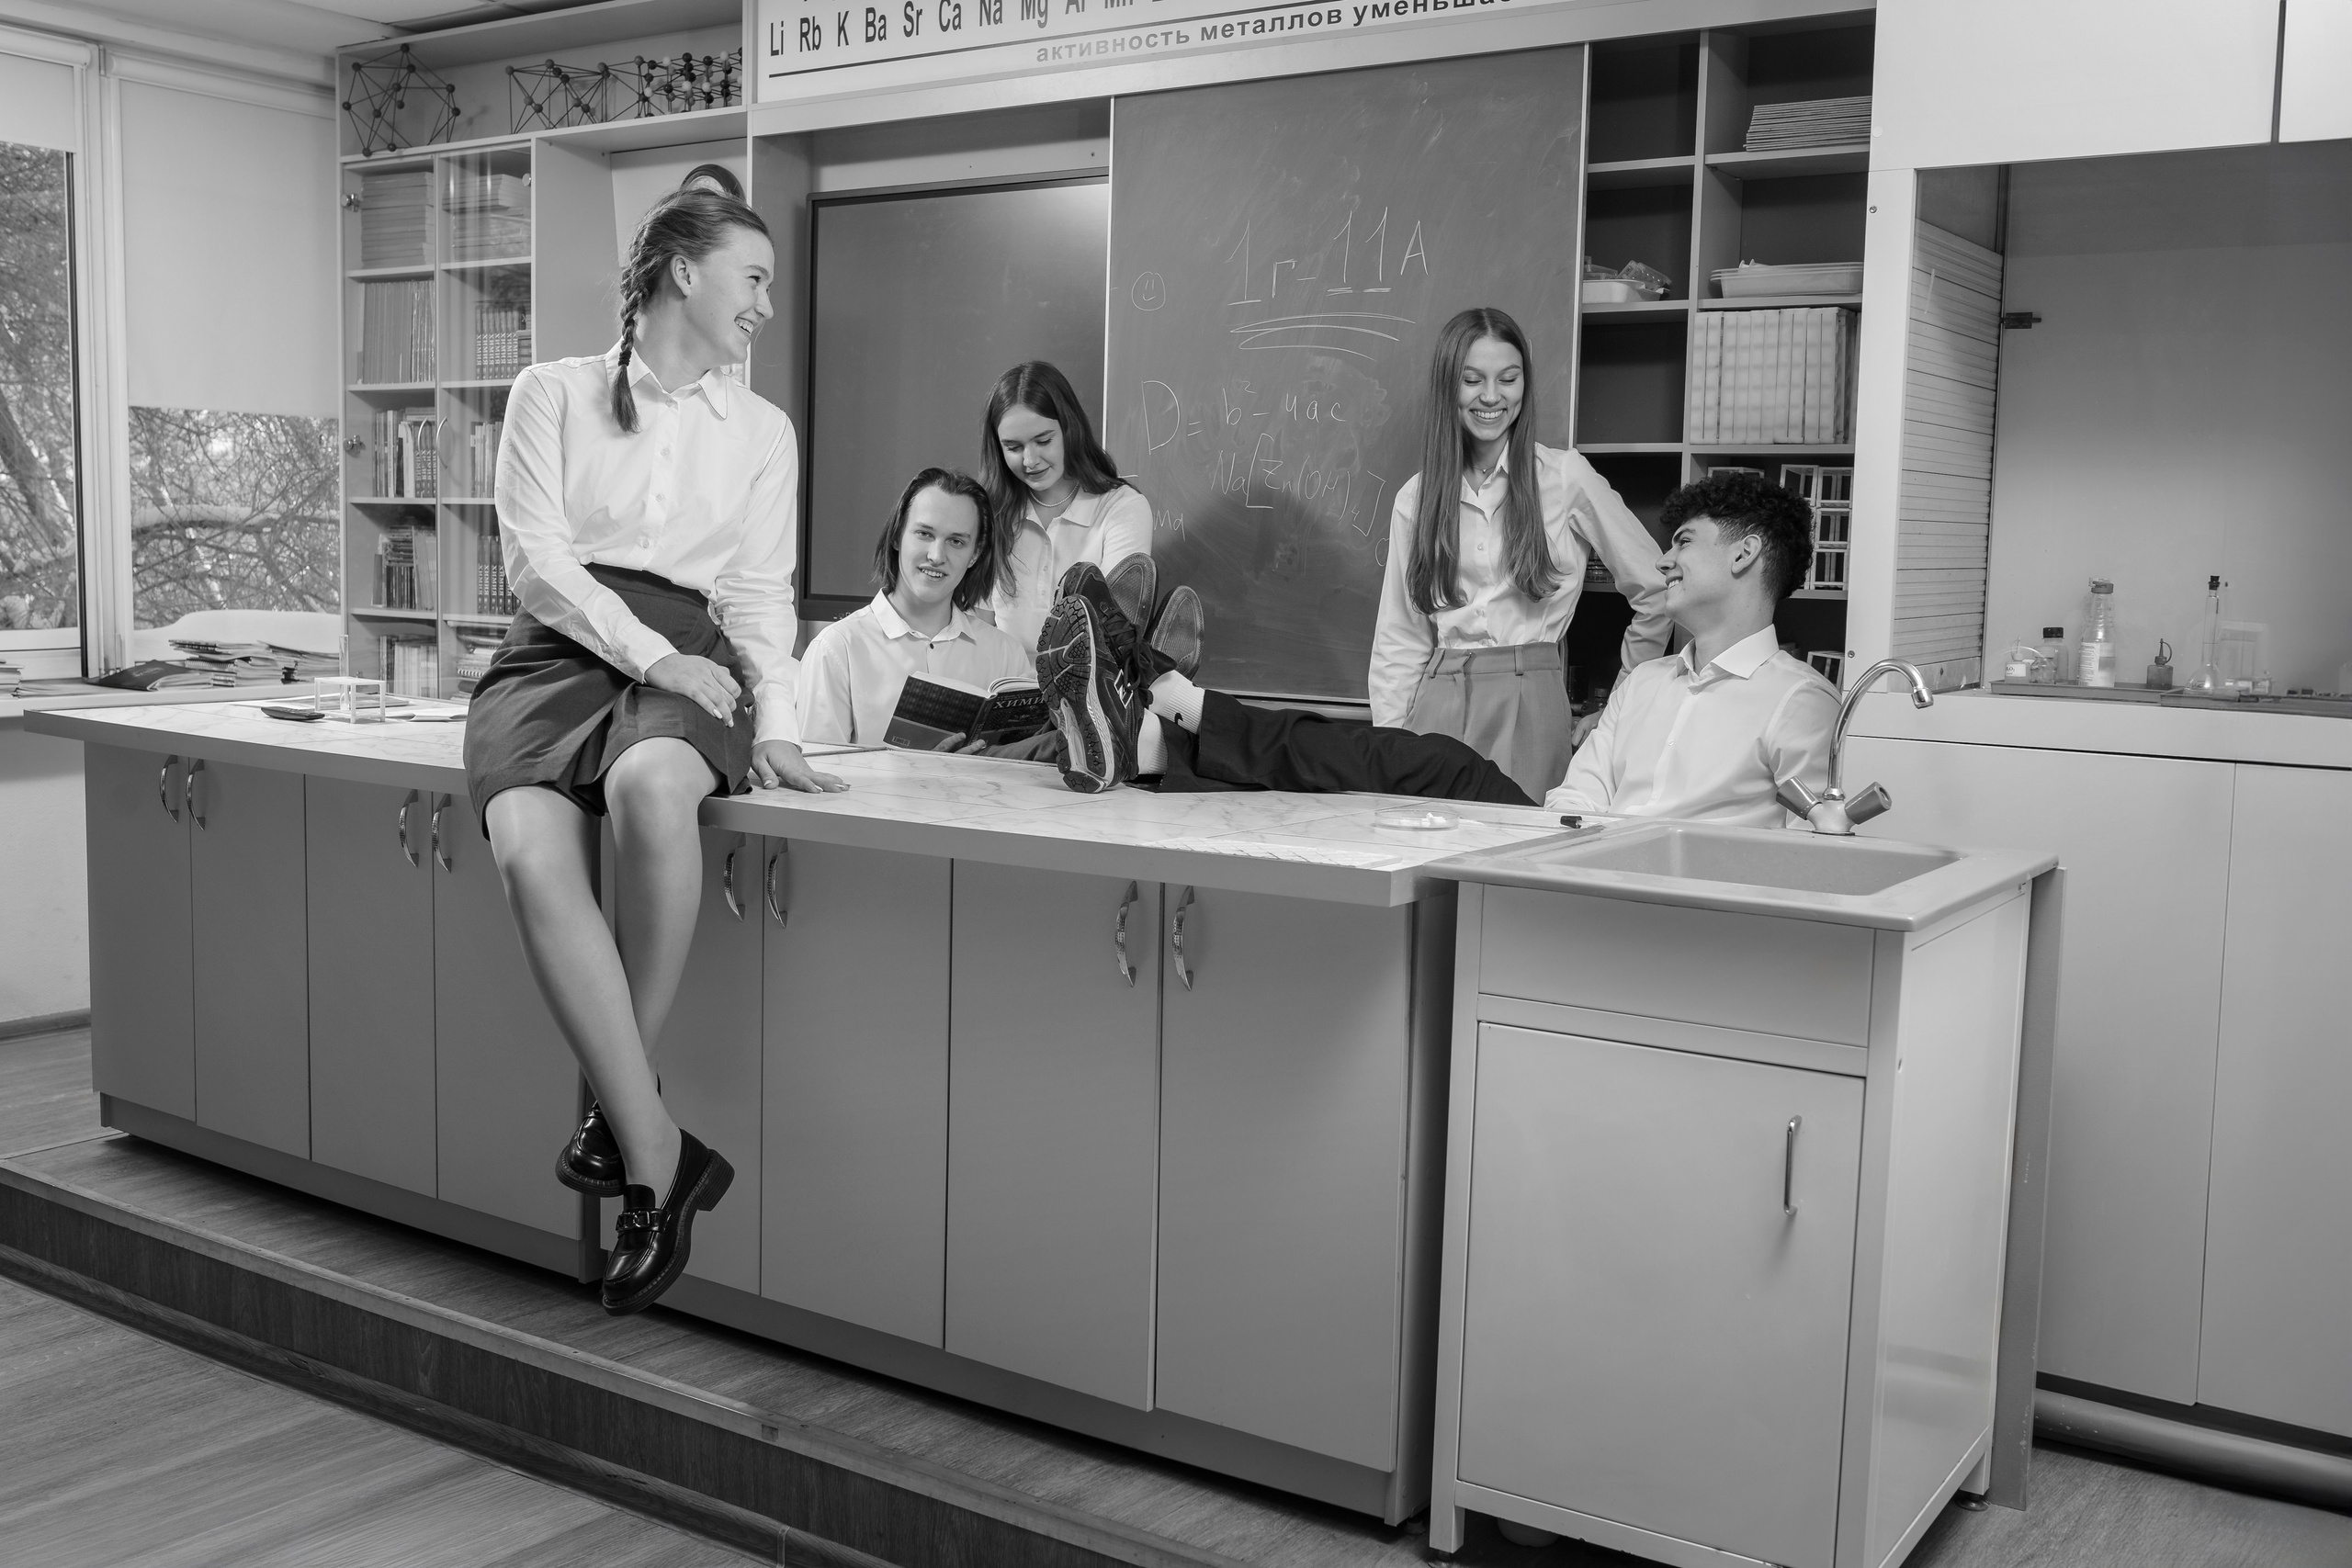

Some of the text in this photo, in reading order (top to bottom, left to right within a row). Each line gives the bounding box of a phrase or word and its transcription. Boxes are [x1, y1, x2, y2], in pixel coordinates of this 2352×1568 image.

[771, 0, 1049, 57] Li Rb K Ba Sr Ca Na Mg
[1036, 0, 1511, 62] активность металлов уменьш
[993, 697, 1045, 710] ХИМИ
